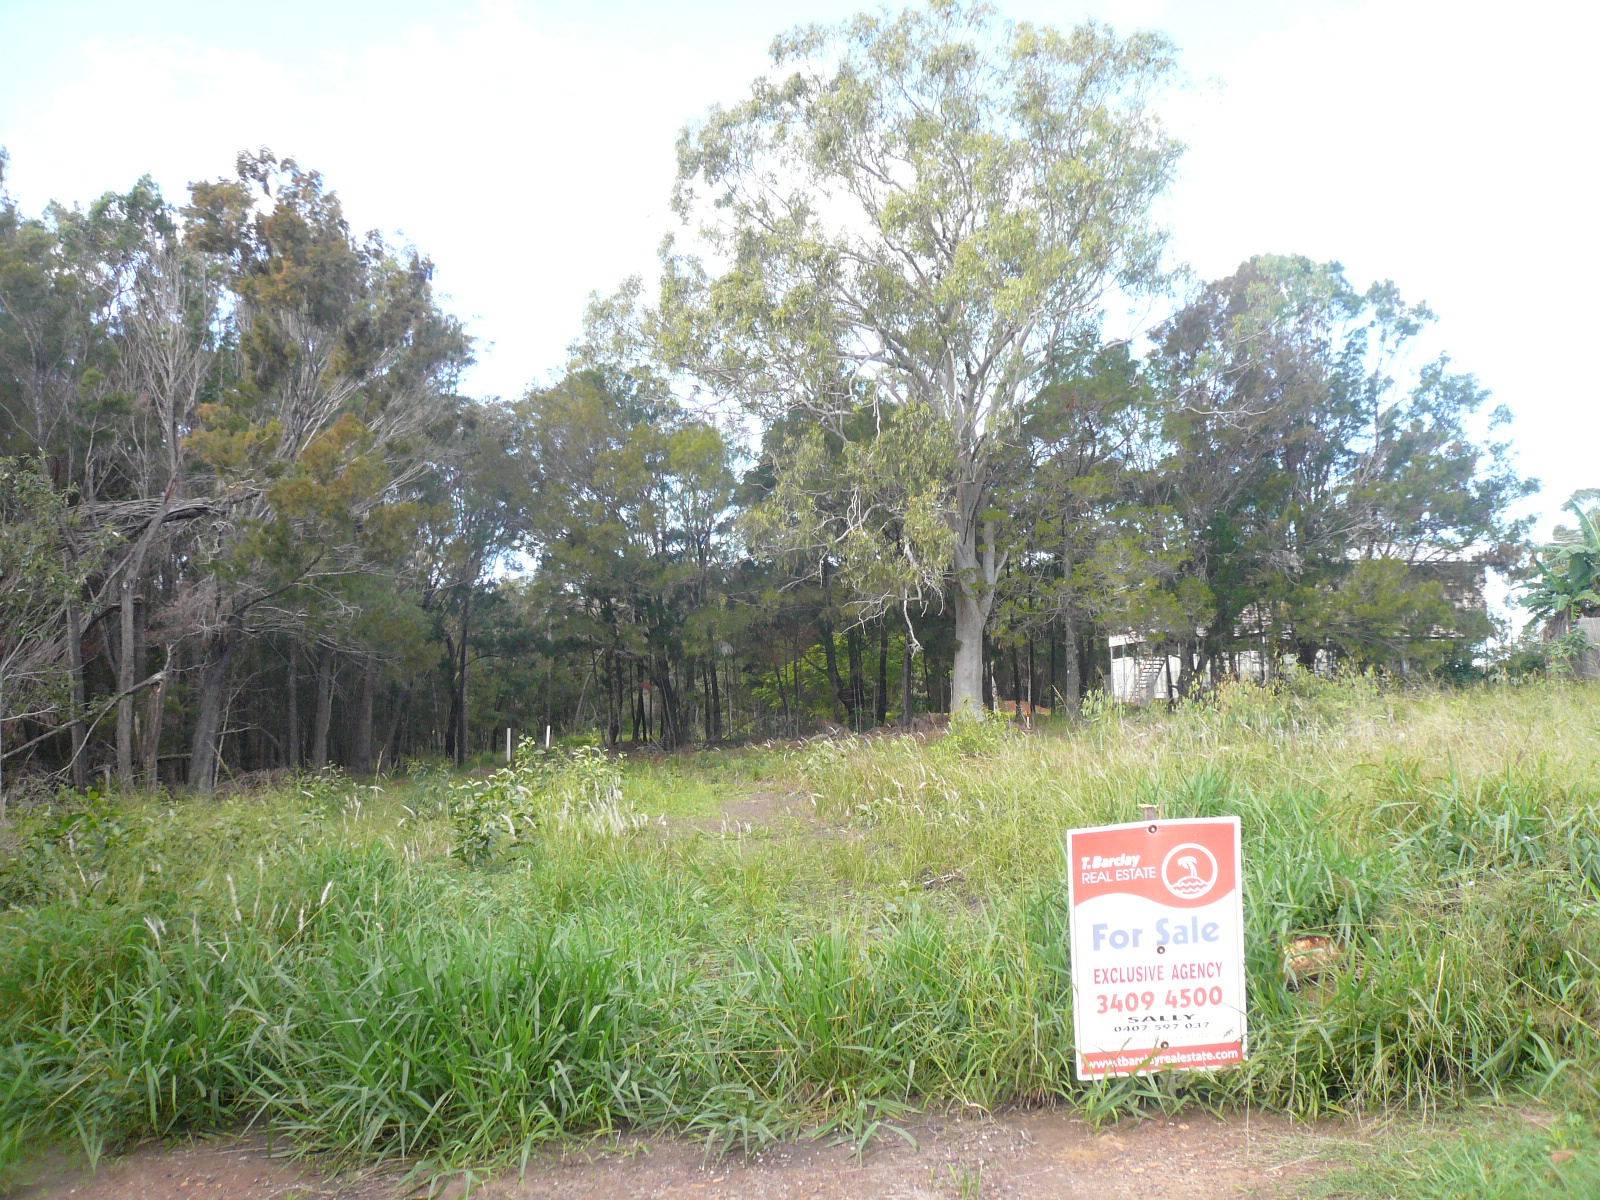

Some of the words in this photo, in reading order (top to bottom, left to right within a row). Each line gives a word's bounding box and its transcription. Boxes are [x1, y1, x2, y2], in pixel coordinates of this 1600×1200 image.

[1081, 871, 1114, 885] REAL
[1115, 866, 1157, 881] ESTATE
[1092, 923, 1143, 951] For
[1155, 916, 1219, 946] Sale
[1094, 965, 1165, 985] EXCLUSIVE
[1171, 961, 1223, 981] AGENCY
[1096, 990, 1155, 1015] 3409
[1165, 985, 1223, 1009] 4500
[1114, 1025, 1148, 1033] 0407
[1127, 1013, 1195, 1024] SALLY
